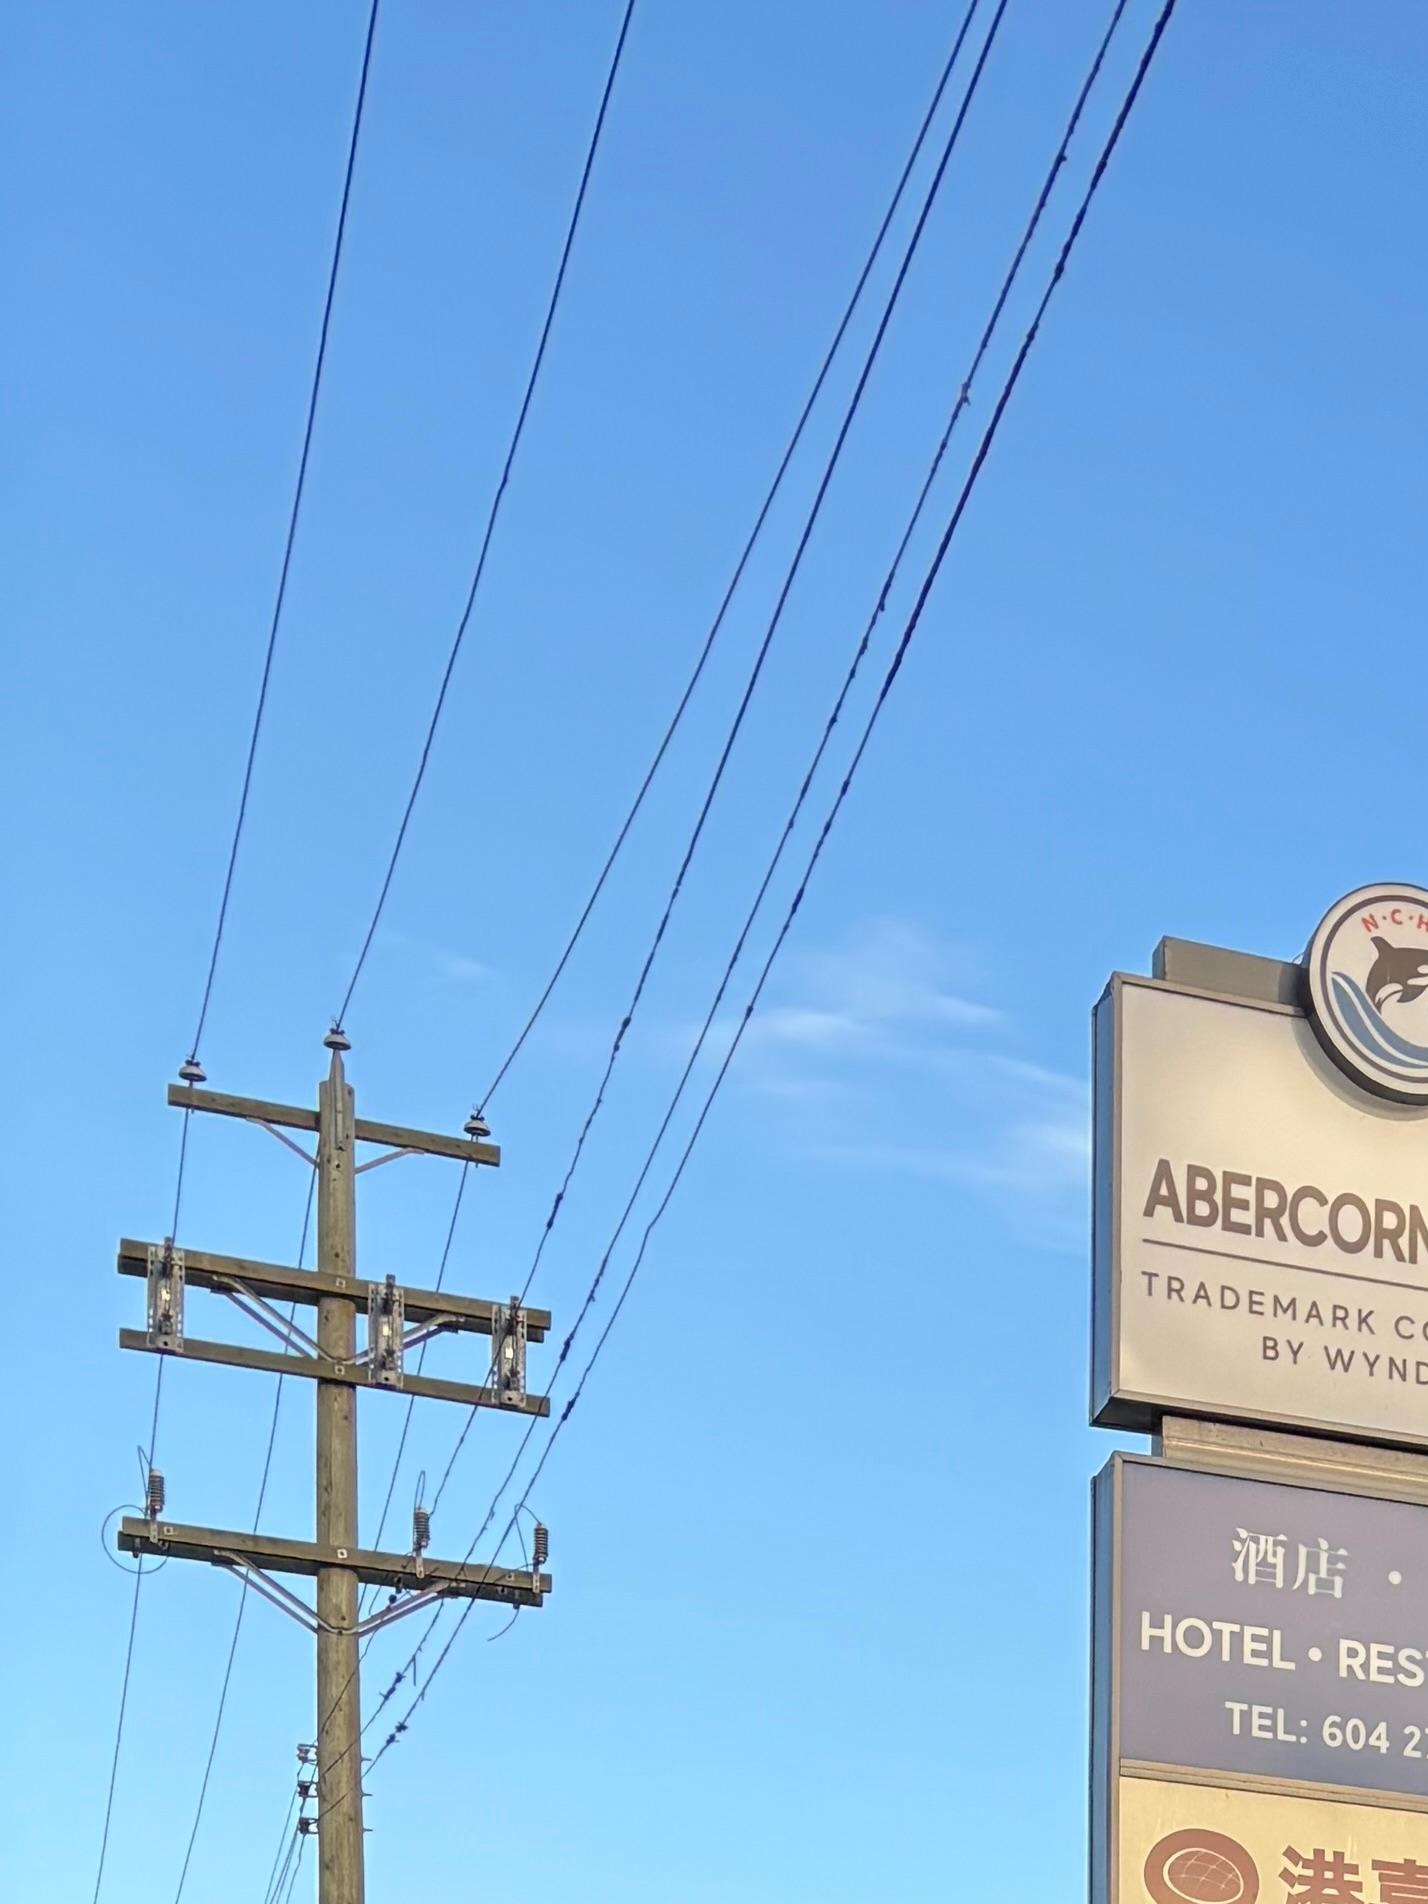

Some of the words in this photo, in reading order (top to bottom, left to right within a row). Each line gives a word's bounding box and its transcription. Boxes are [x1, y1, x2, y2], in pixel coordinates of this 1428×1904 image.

[1141, 1271, 1376, 1336] TRADEMARK
[1262, 1337, 1304, 1366] BY
[1231, 1528, 1350, 1599] 酒店
[1140, 1611, 1296, 1671] HOTEL
[1225, 1702, 1307, 1744] TEL:
[1322, 1715, 1390, 1754] 604
